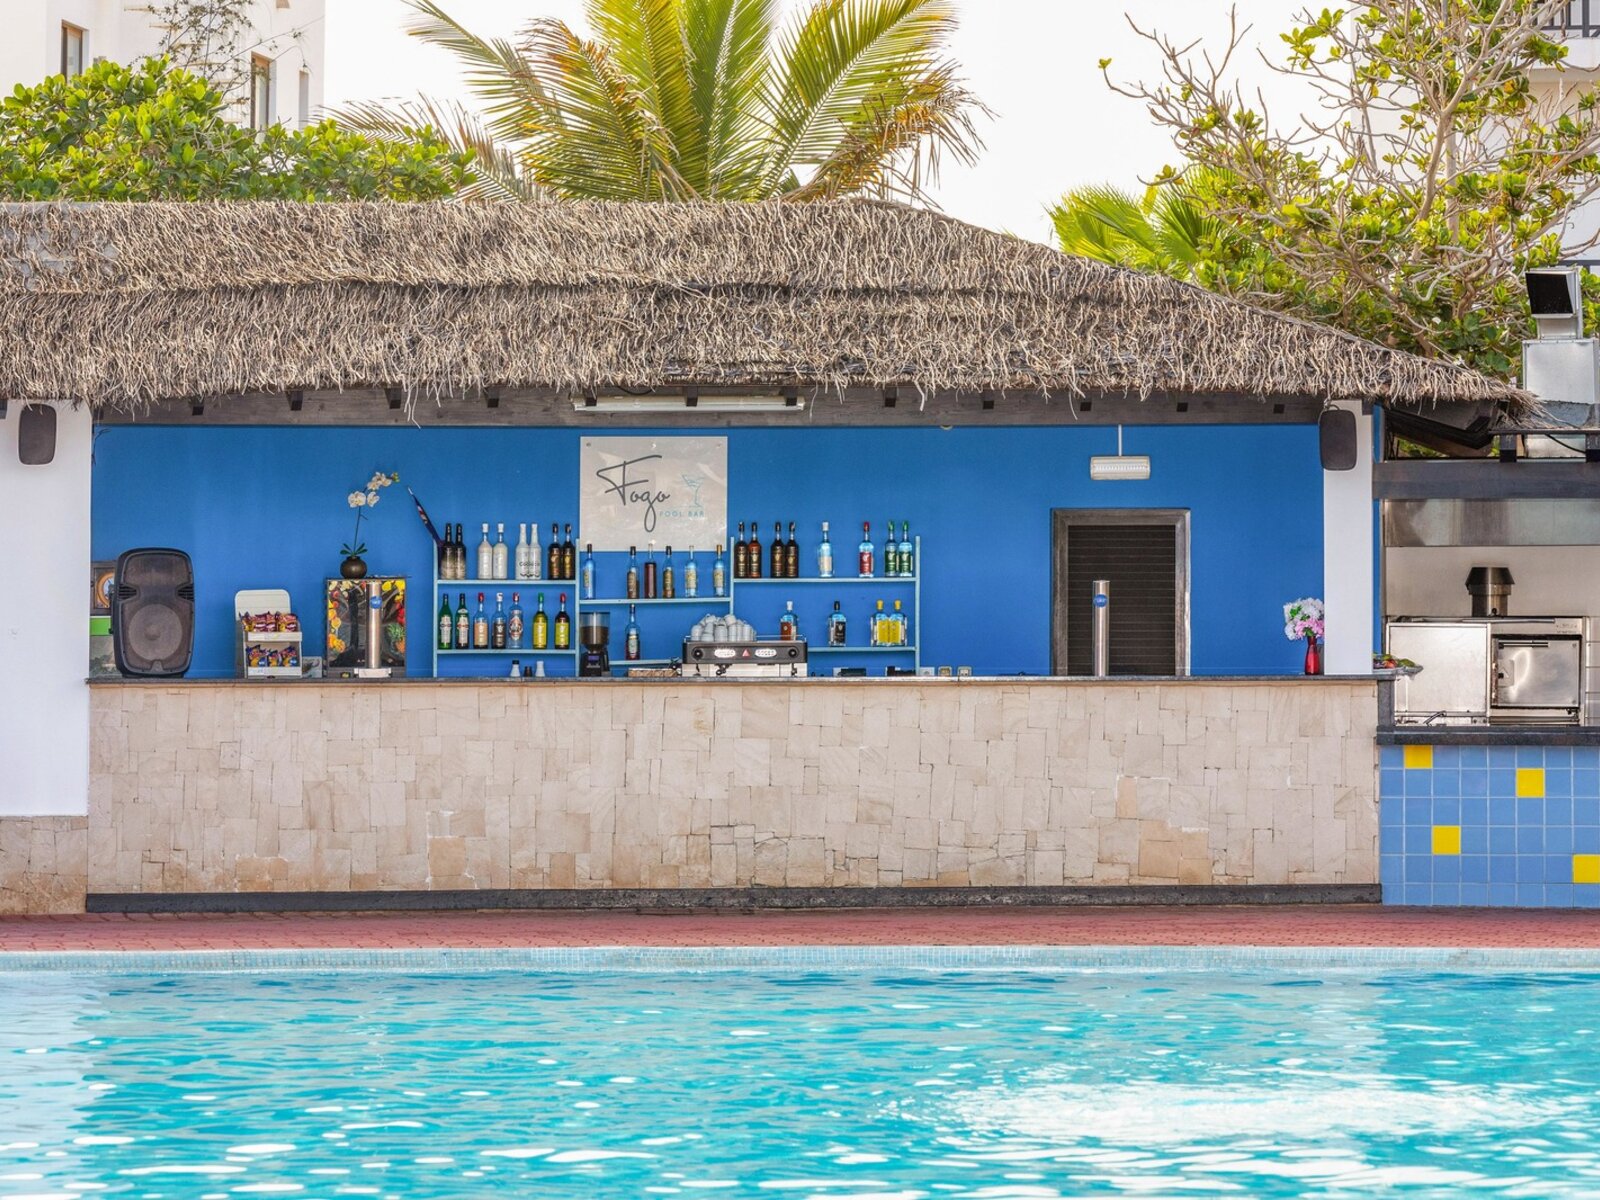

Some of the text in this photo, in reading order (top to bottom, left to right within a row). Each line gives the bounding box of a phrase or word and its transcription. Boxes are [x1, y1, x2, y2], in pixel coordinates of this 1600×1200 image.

[596, 454, 671, 533] Fogo
[659, 510, 705, 518] POOL BAR
